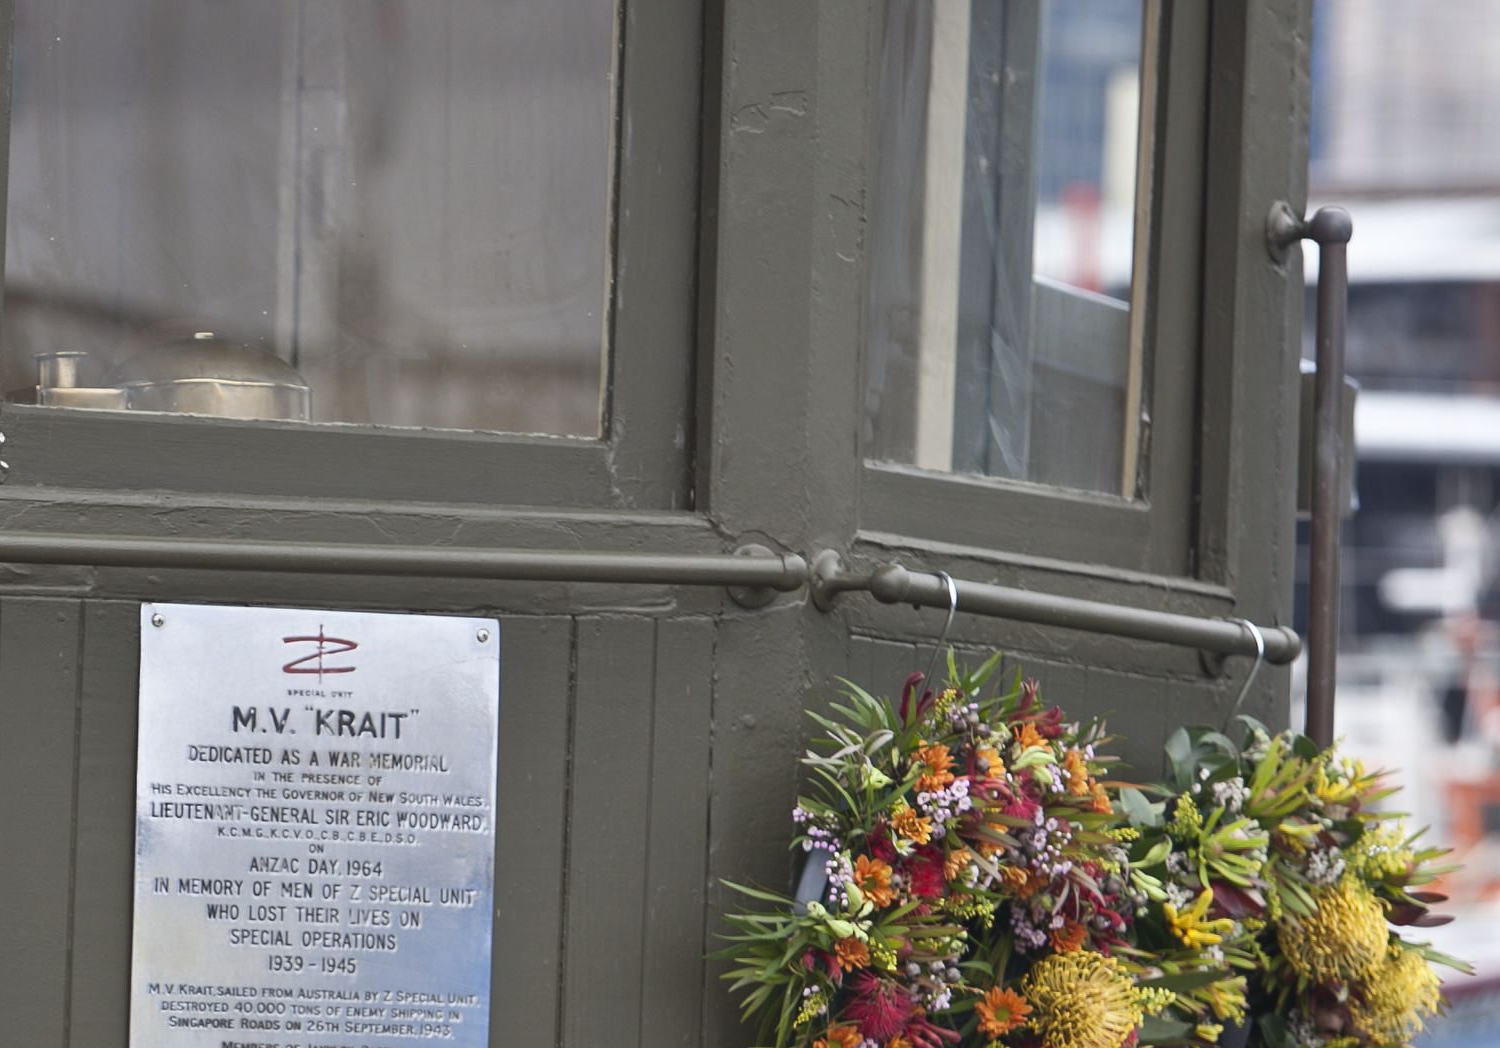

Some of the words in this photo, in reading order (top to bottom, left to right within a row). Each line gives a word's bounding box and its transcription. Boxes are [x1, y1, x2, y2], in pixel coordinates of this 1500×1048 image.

[287, 688, 325, 698] SPECIAL
[330, 690, 354, 699] UNIT
[232, 706, 296, 735] M.V.
[305, 706, 419, 739] "KRAIT"
[188, 745, 272, 765] DEDICATED
[281, 749, 300, 766] AS
[309, 751, 319, 767] A
[329, 751, 360, 768] WAR
[369, 753, 449, 772] MEMORIAL
[253, 771, 265, 782] IN
[272, 772, 294, 783] THE
[301, 773, 360, 785] PRESENCE
[368, 776, 383, 786] OF
[151, 783, 172, 795] HIS
[176, 784, 251, 798] EXCELLENCY
[256, 788, 277, 799] THE
[282, 788, 344, 801] GOVERNOR
[348, 792, 363, 802] OF
[369, 791, 395, 803] NEW
[400, 792, 439, 805] SOUTH
[151, 801, 319, 824] LIEUTENANT-GENERAL
[325, 809, 349, 826] SIR
[356, 810, 390, 827] ERIC
[309, 844, 324, 853] ON
[250, 857, 300, 873] ANZAC
[154, 878, 169, 893] IN
[178, 878, 243, 895] MEMORY
[253, 881, 272, 897] OF
[281, 882, 313, 898] MEN
[322, 884, 341, 900] OF
[350, 884, 360, 900] Z
[369, 885, 431, 903] SPECIAL
[440, 888, 475, 905] UNIT
[207, 904, 239, 920] WHO
[249, 905, 286, 922] LOST
[296, 906, 339, 923] THEIR
[349, 909, 390, 926] LIVES
[400, 910, 420, 927] ON
[230, 929, 292, 946] SPECIAL
[302, 931, 396, 950] OPERATIONS
[268, 955, 304, 972] 1939
[322, 957, 356, 973] 1945
[262, 988, 293, 999] FROM
[297, 988, 360, 1001] AUSTRALIA
[365, 991, 378, 1001] BY
[383, 991, 393, 1002] Z
[396, 991, 444, 1004] SPECIAL
[161, 1001, 229, 1013] DESTROYED
[291, 1005, 321, 1016] TONS
[326, 1007, 341, 1017] OF
[346, 1007, 386, 1018] ENEMY
[391, 1008, 444, 1021] SHIPPING
[448, 1011, 461, 1021] IN
[168, 1015, 234, 1029] SINGAPORE
[241, 1018, 280, 1030] ROADS
[285, 1021, 301, 1031] ON
[307, 1020, 339, 1033] 26TH
